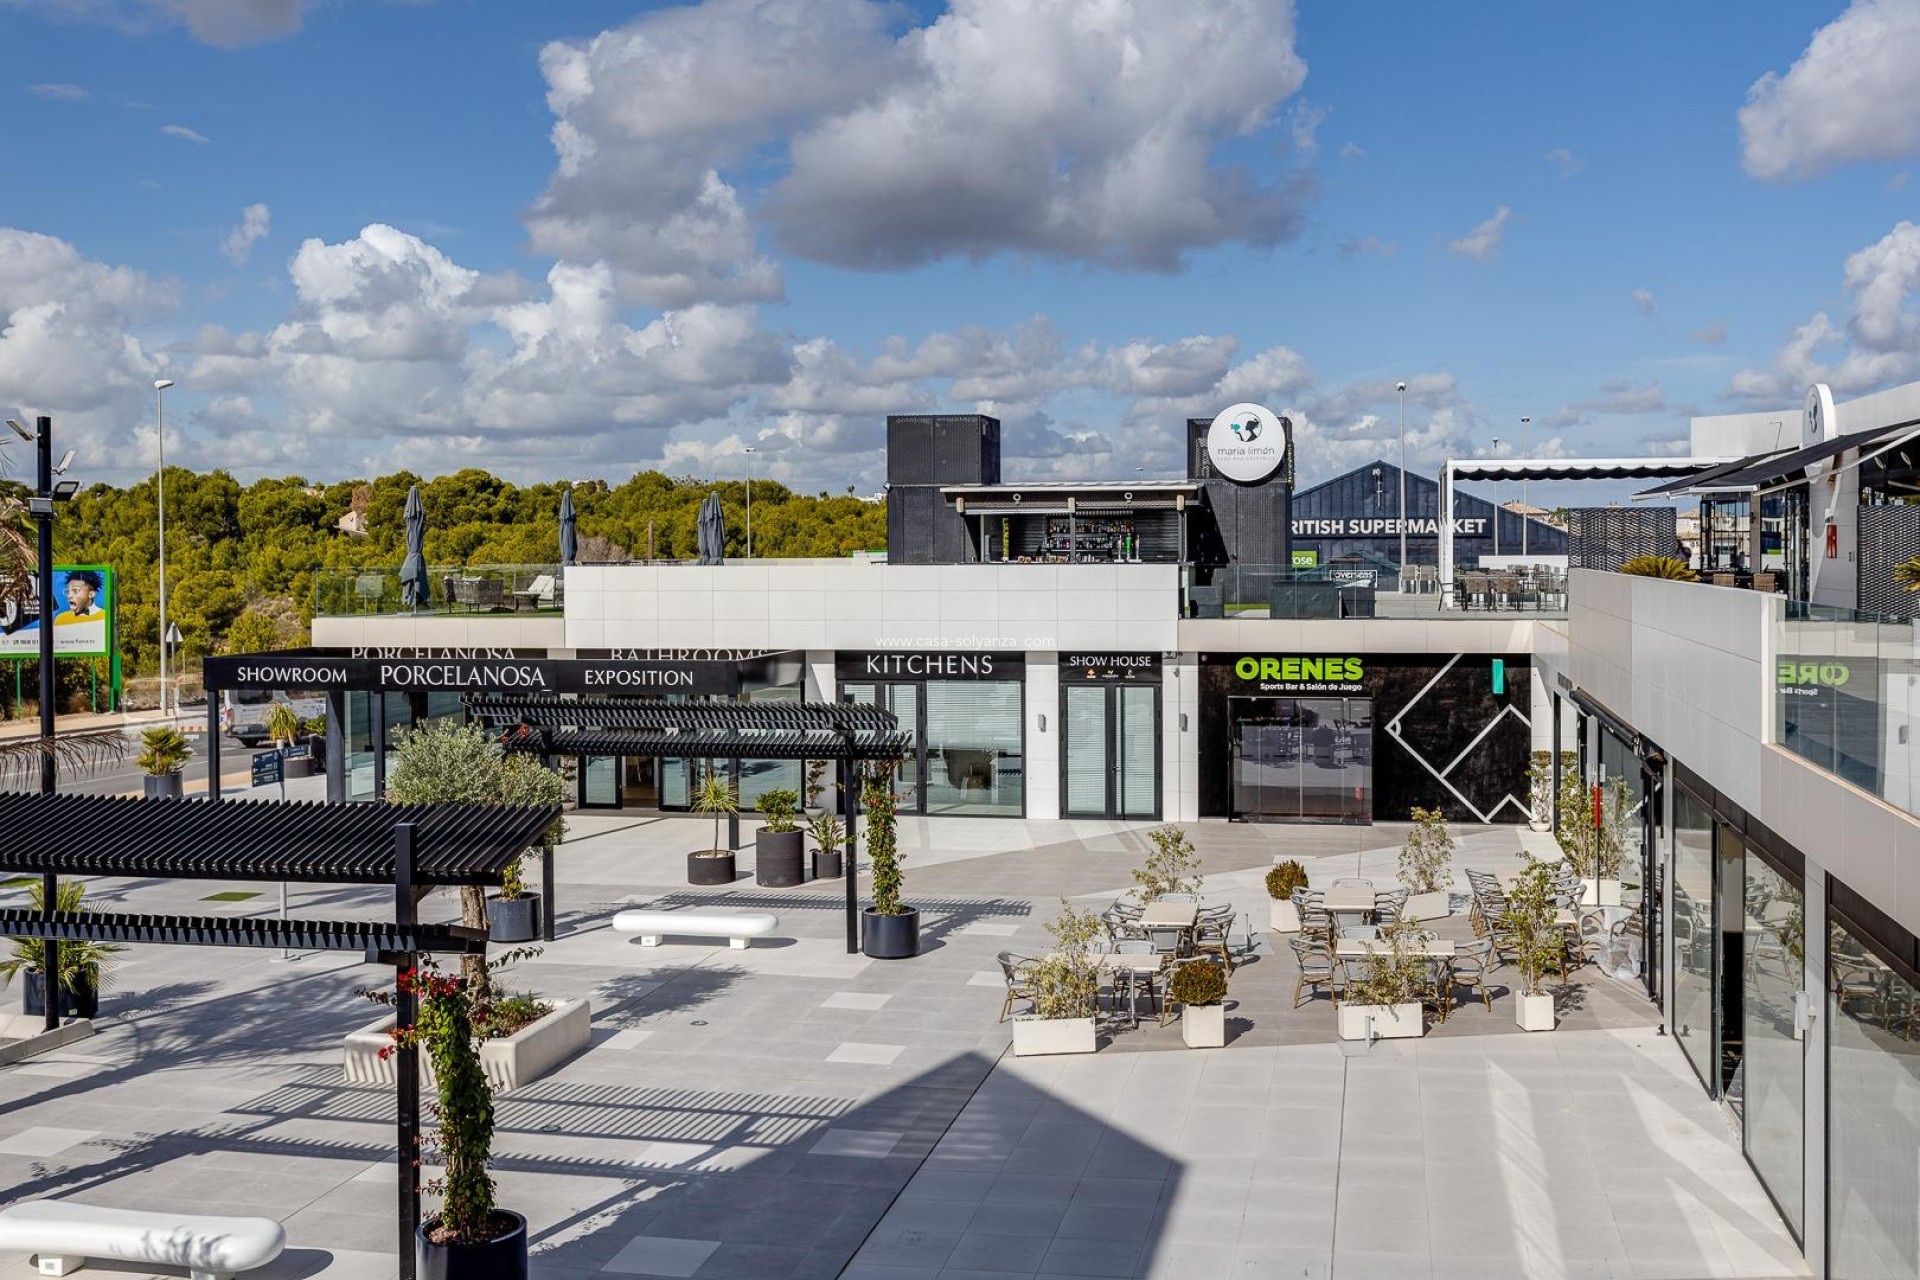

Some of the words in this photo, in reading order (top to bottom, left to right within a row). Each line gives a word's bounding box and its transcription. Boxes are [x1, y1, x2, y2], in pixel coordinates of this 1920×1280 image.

[1348, 518, 1487, 535] SUPERMAKET
[1291, 556, 1313, 565] ose
[866, 654, 994, 675] KITCHENS
[1069, 655, 1108, 667] SHOW
[1111, 655, 1152, 667] HOUSE
[1235, 656, 1364, 681] ORENES
[237, 665, 347, 683] SHOWROOM
[380, 664, 546, 686] PORCELANOSA
[584, 669, 693, 686] EXPOSITION
[1260, 683, 1284, 691] Sports
[1285, 683, 1299, 691] Bar
[1328, 683, 1338, 691] de
[1339, 683, 1363, 692] Juego
